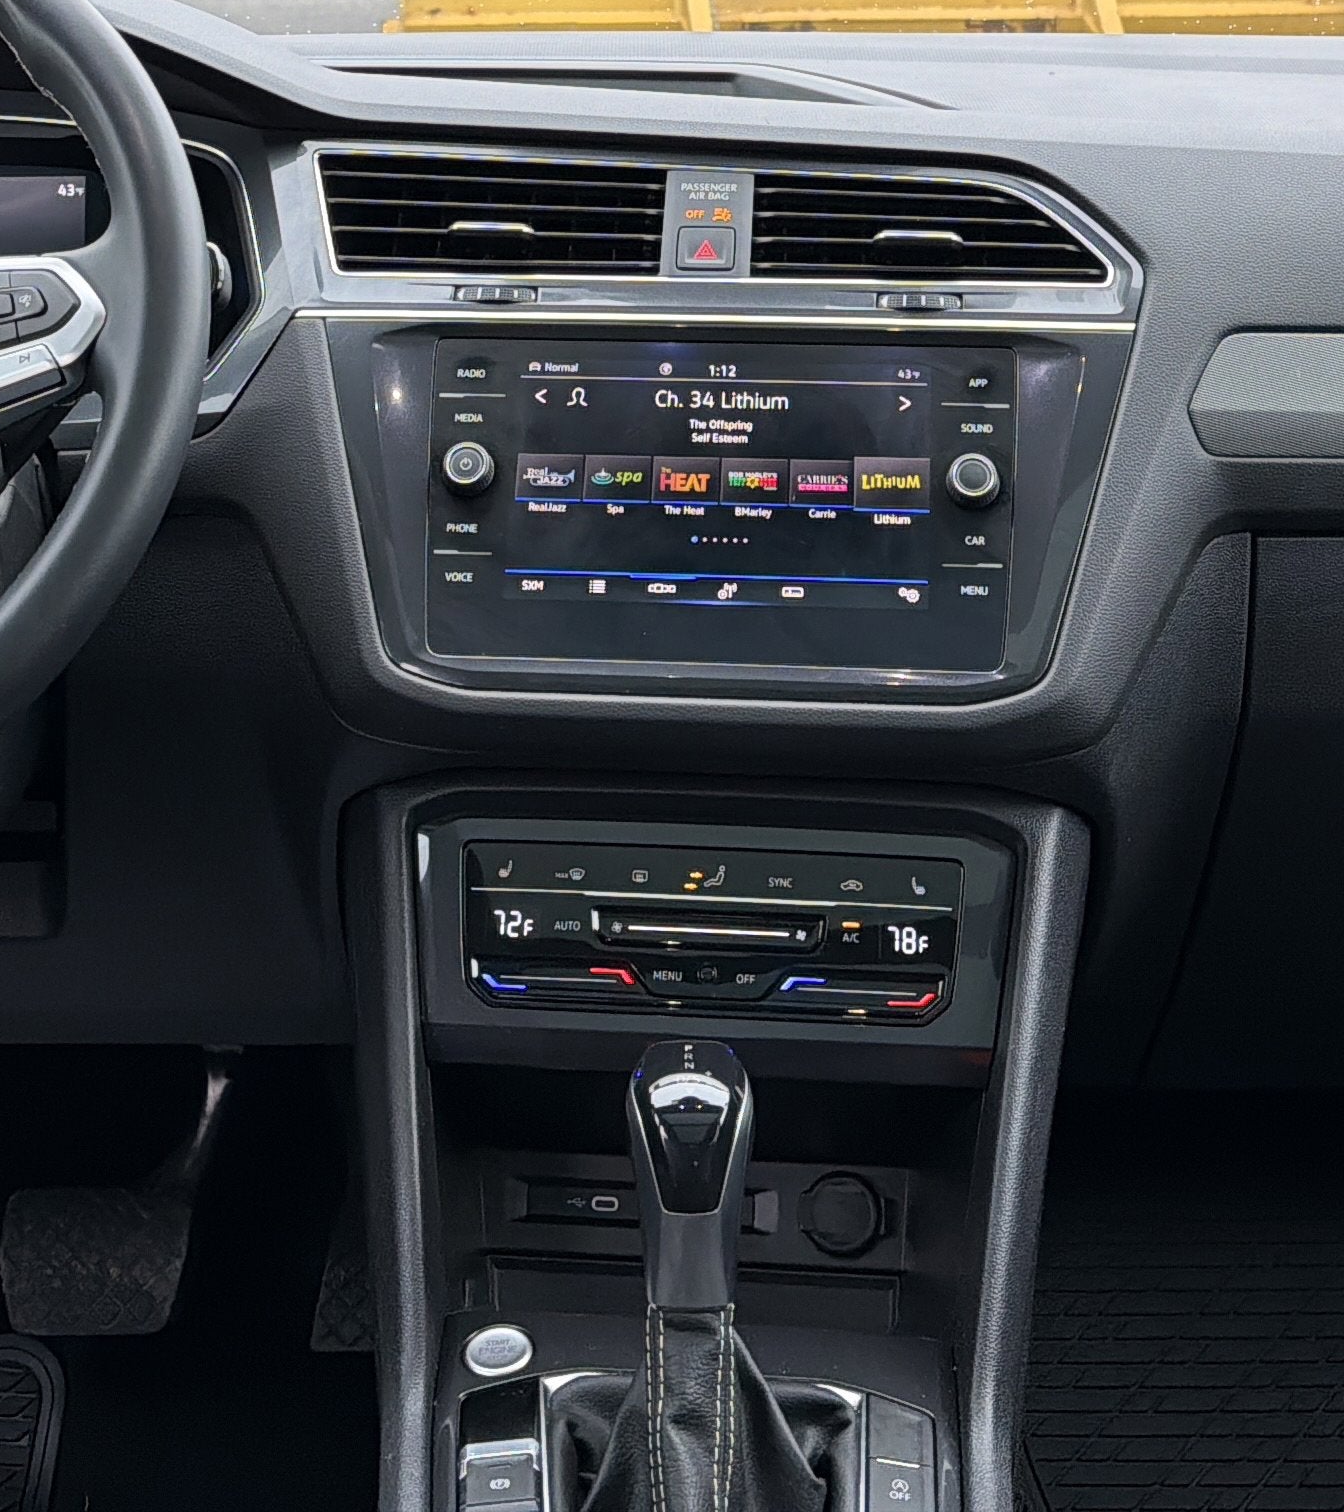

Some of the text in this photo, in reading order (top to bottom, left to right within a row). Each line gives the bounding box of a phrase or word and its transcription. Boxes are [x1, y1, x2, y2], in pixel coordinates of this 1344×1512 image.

[680, 182, 738, 192] PASSENGER
[688, 191, 730, 201] AIR BAG
[685, 209, 705, 219] OFF
[544, 362, 580, 373] Normal
[709, 364, 737, 378] 1:12
[456, 368, 486, 379] RADIO
[968, 378, 989, 388] APP
[654, 389, 789, 410] Ch. 34 Lithium
[454, 413, 484, 423] MEDIA
[688, 419, 754, 432] The Offspring
[960, 423, 994, 434] SOUND
[691, 432, 749, 444] Self Esteem
[614, 470, 643, 486] spa
[659, 473, 711, 492] HEAT
[606, 504, 625, 516] Spa
[664, 505, 705, 516] The Heat
[734, 507, 773, 519] BMarley
[808, 509, 837, 519] Carrie
[873, 514, 912, 525] Lithium
[446, 523, 478, 534] PHONE
[964, 535, 986, 546] CAR
[444, 572, 474, 583] VOICE
[521, 579, 545, 591] SXM
[960, 585, 989, 596] MENU
[768, 877, 793, 888] SYNC
[554, 921, 581, 932] AUTO
[842, 933, 860, 944] A/C
[653, 970, 683, 982] MENU
[736, 974, 756, 985] OFF
[684, 1044, 693, 1052] P
[684, 1052, 694, 1060] R
[684, 1061, 695, 1070] N
[484, 1339, 510, 1348] START
[478, 1345, 518, 1356] ENGINE
[889, 1490, 912, 1502] OFF
